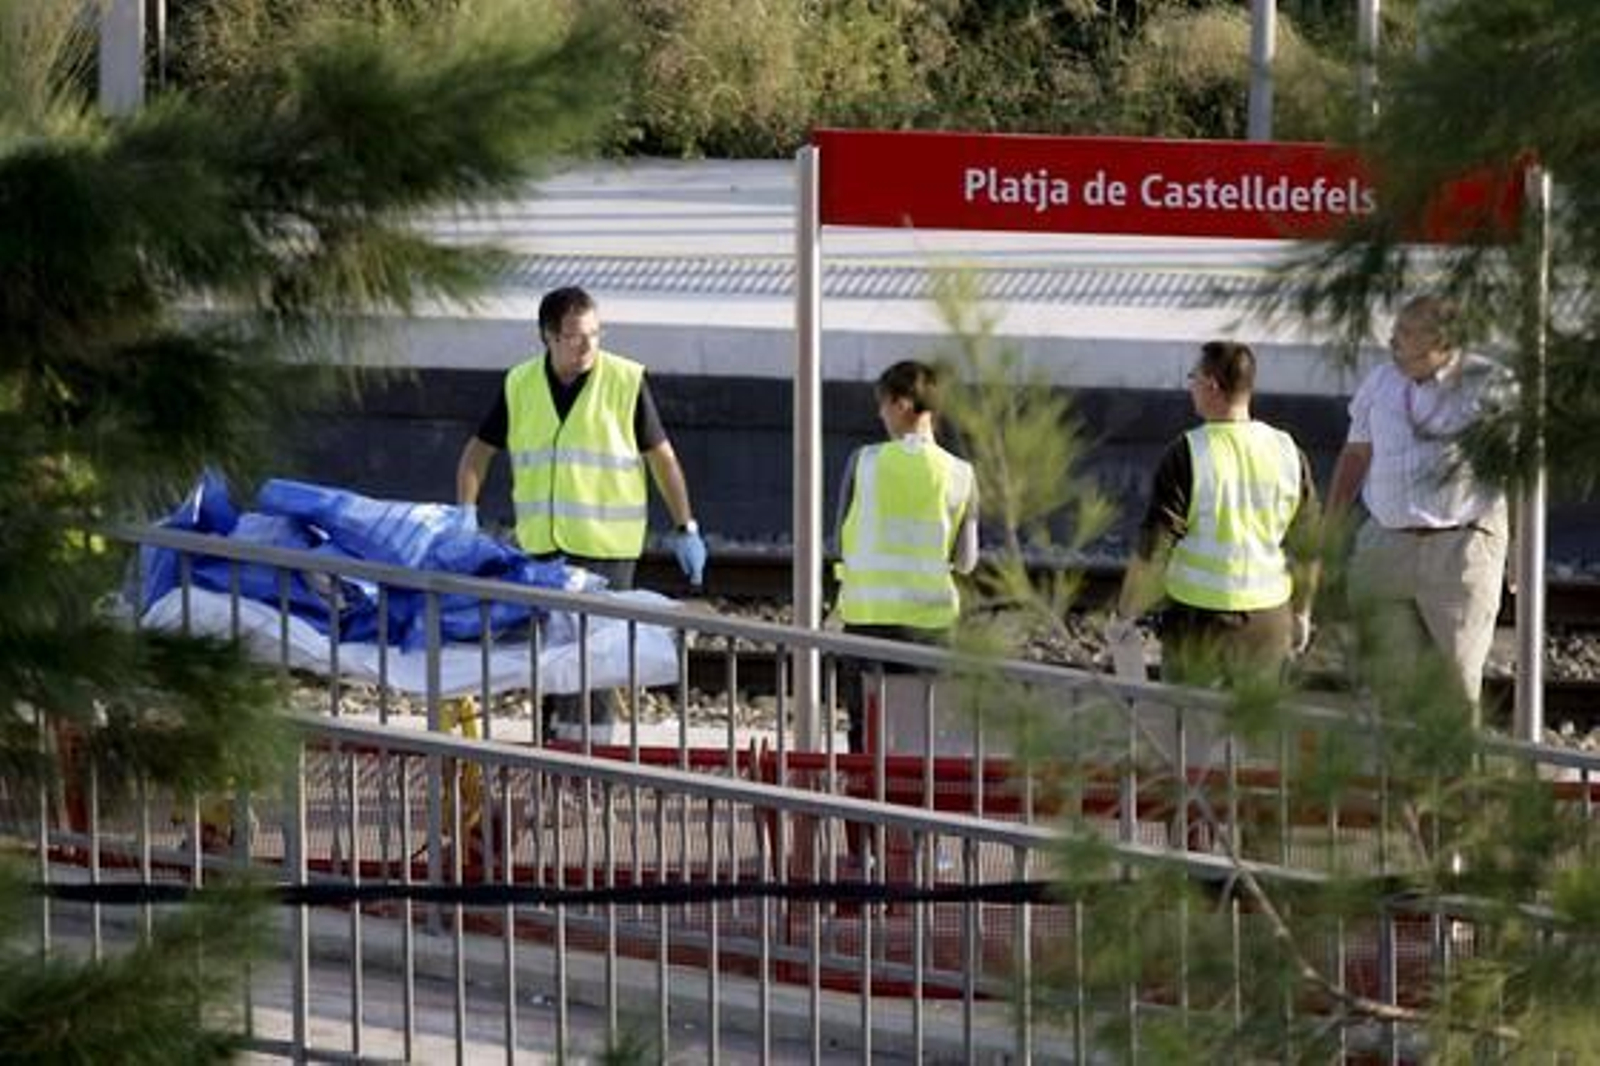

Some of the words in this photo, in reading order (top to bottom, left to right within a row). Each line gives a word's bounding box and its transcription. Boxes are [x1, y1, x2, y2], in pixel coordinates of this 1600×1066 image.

[964, 168, 1069, 211] Platja
[1083, 171, 1126, 205] de
[1140, 174, 1377, 214] Castelldefels
